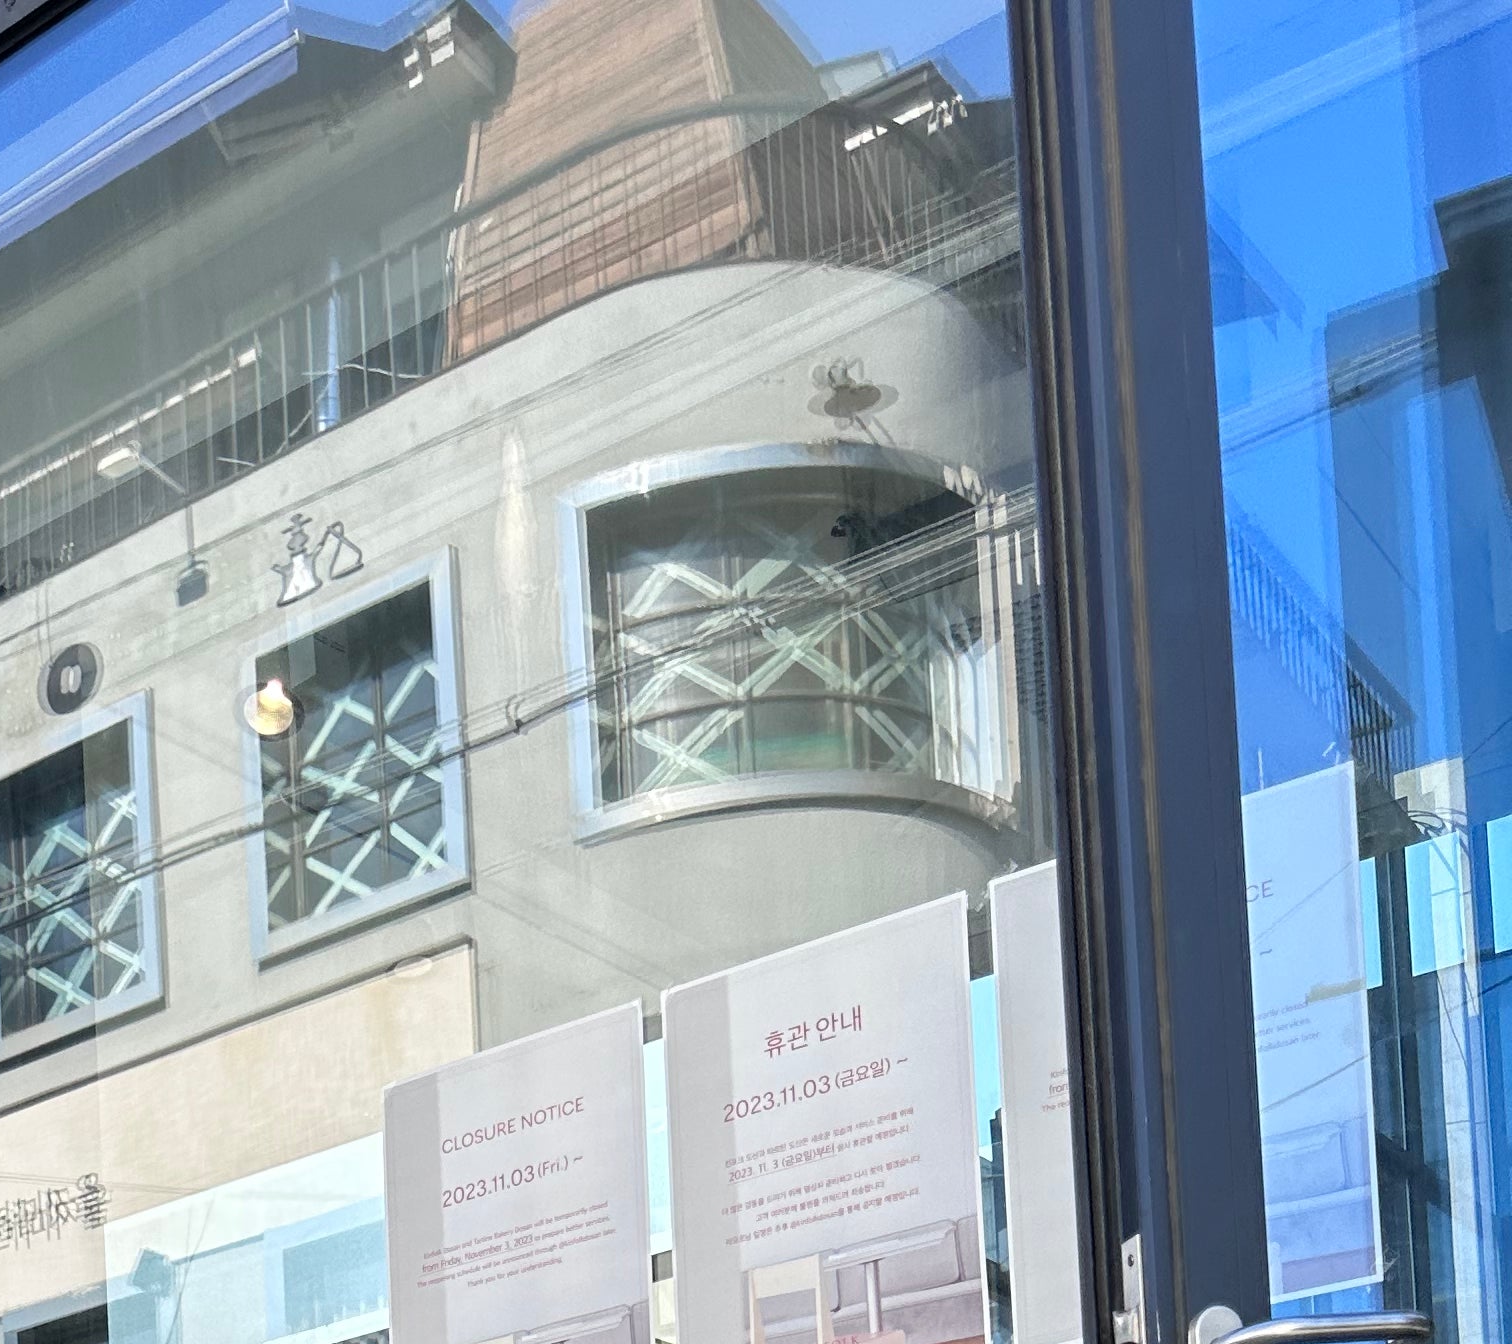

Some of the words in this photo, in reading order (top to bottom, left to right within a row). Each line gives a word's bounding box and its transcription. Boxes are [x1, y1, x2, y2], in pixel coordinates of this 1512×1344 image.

[764, 1021, 810, 1058] 휴관
[816, 1004, 862, 1042] 안내
[442, 1118, 516, 1154] CLOSURE
[521, 1096, 585, 1130] NOTICE
